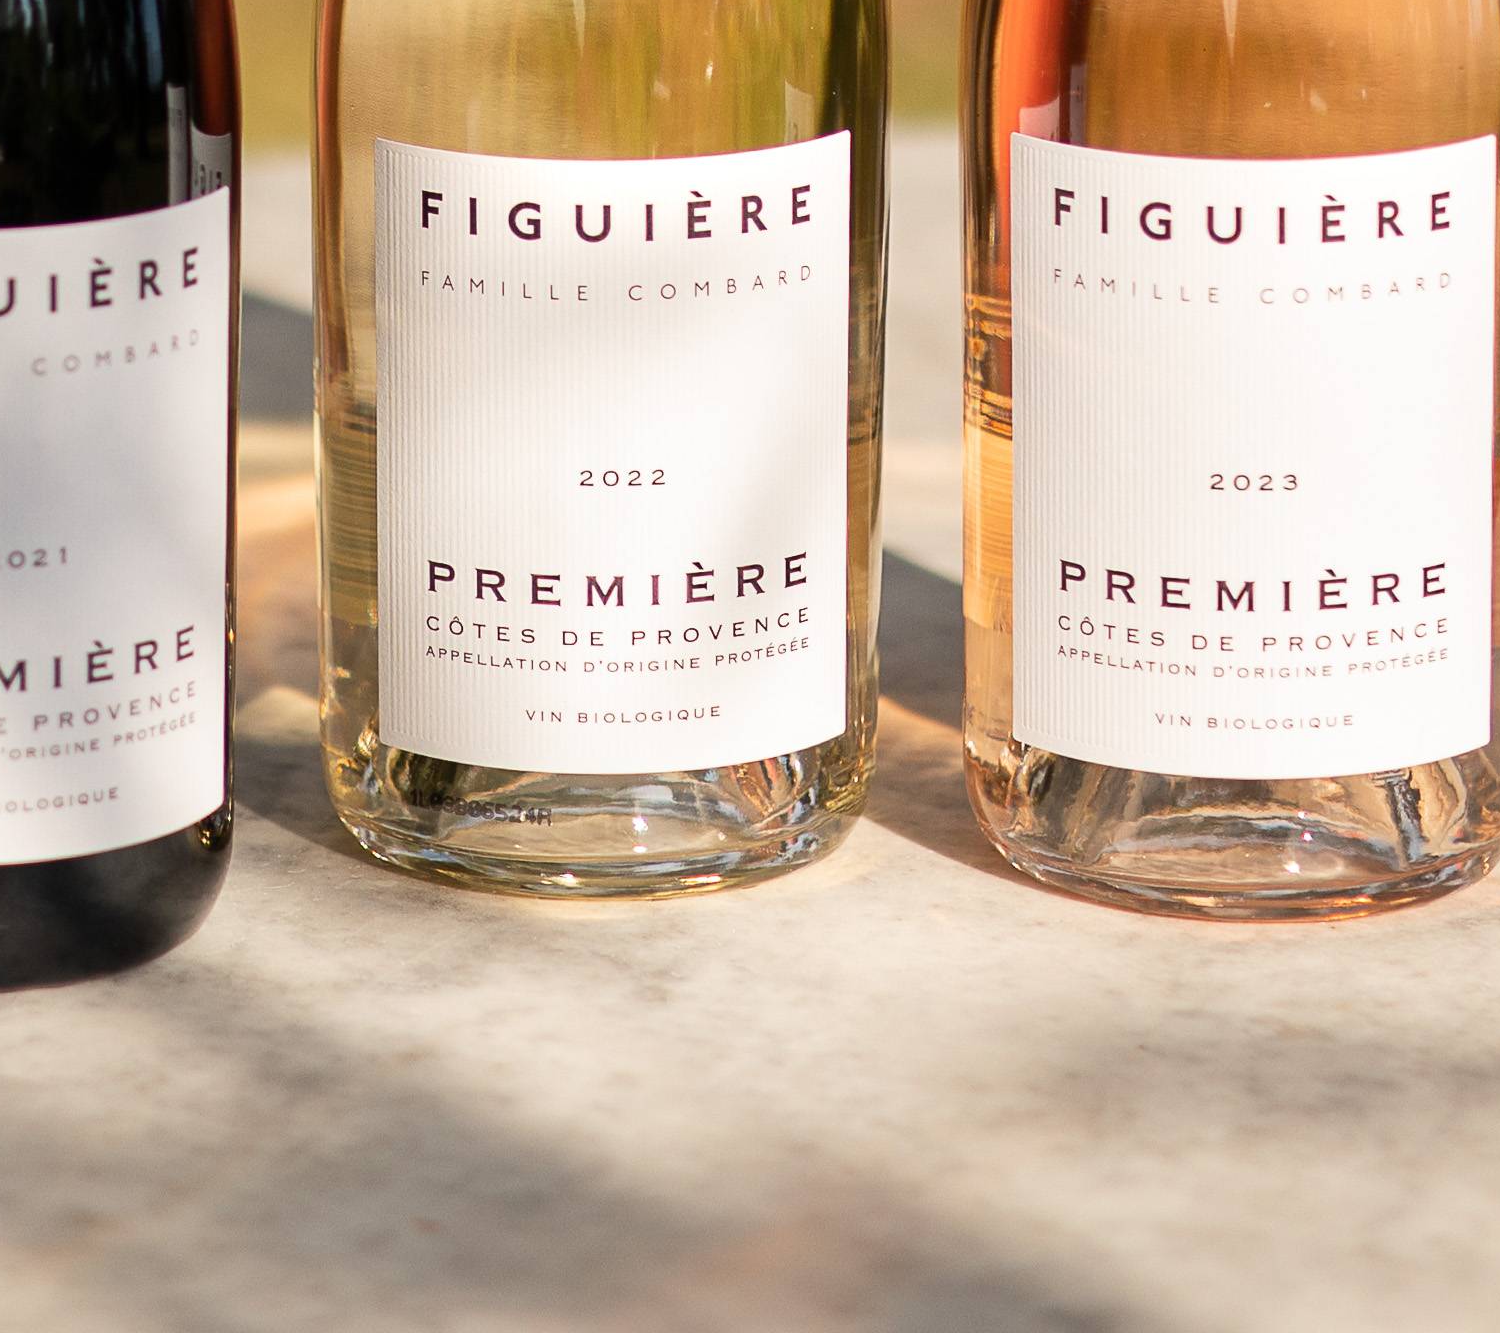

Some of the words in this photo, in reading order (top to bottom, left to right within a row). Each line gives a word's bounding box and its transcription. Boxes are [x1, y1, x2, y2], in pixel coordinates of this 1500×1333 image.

[421, 183, 812, 244] FIGUIÈRE
[1053, 187, 1453, 247] FIGUIÈRE
[420, 269, 590, 303] FAMILLE
[627, 263, 812, 302] COMBARD
[1053, 268, 1221, 304] FAMILLE
[1259, 271, 1453, 305] COMBARD
[30, 328, 200, 378] COMBARD
[578, 468, 667, 488] 2022
[1209, 473, 1300, 492] 2023
[426, 550, 809, 609] PREMIÈRE
[1058, 558, 1449, 615] PREMIÈRE
[425, 615, 536, 646] CÔTES
[561, 630, 605, 647] DE
[631, 605, 810, 647] PROVENCE
[1056, 614, 1166, 649] CÔTES
[1191, 633, 1235, 654] DE
[1261, 617, 1450, 653] PROVENCE
[425, 645, 568, 673] APPELLATION
[583, 656, 701, 674] D'ORIGINE
[714, 636, 810, 668] PROTÉGÉE
[1056, 644, 1198, 678] APPELLATION
[1212, 664, 1334, 680] D'ORIGINE
[1347, 647, 1449, 675] PROTÉGÉE
[31, 679, 197, 733] PROVENCE
[525, 708, 563, 724] VIN
[576, 705, 722, 725] BIOLOGIQUE
[1154, 712, 1193, 728] VIN
[1207, 714, 1354, 731] BIOLOGIQUE
[112, 709, 197, 747] PROTÉGÉE
